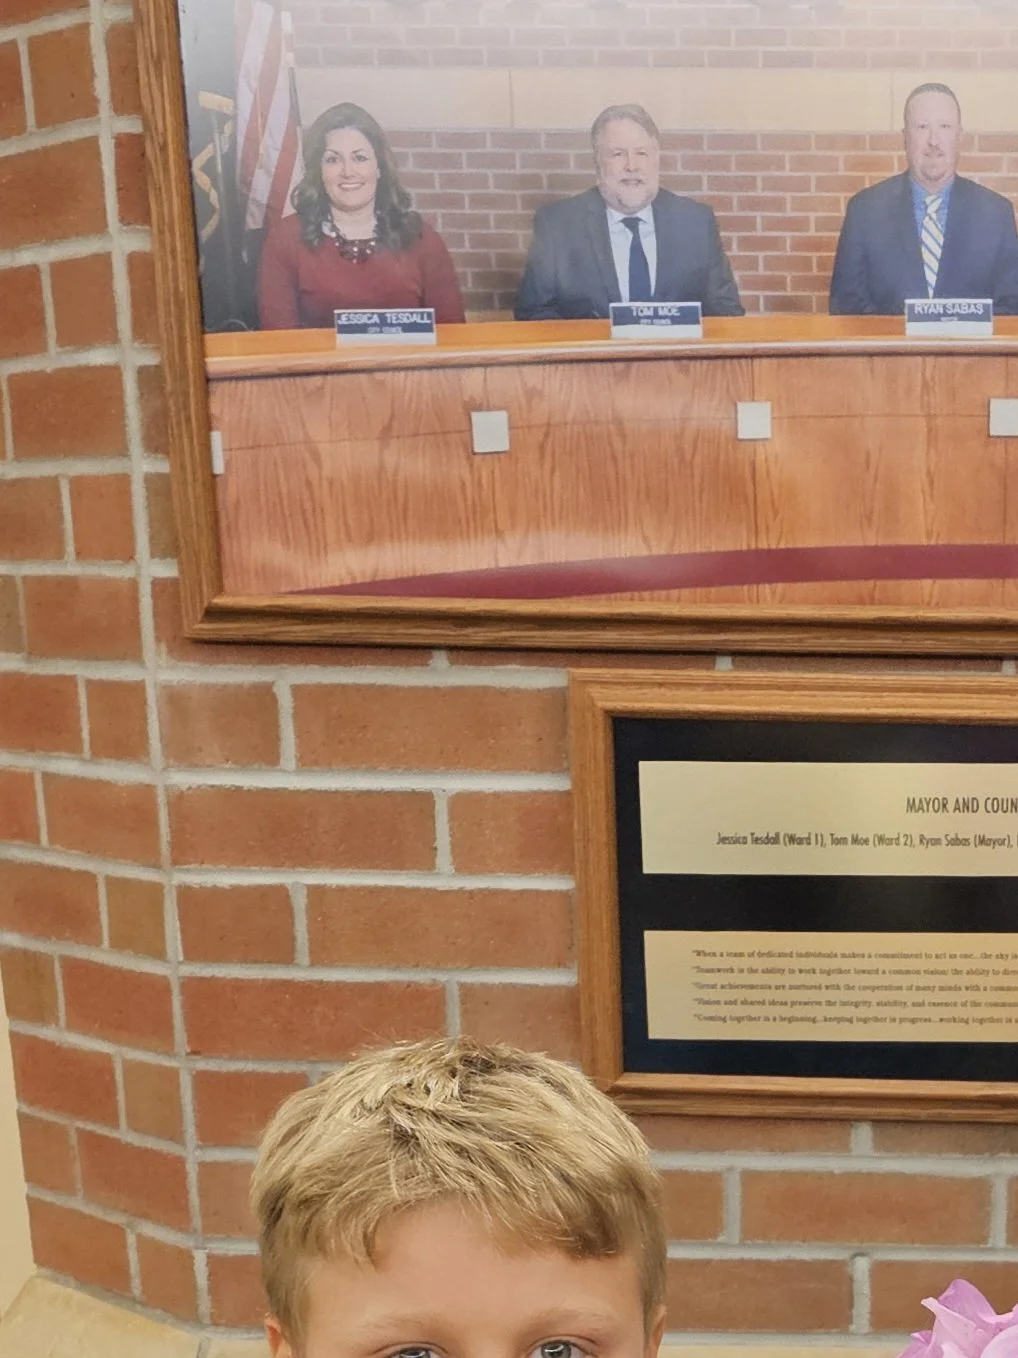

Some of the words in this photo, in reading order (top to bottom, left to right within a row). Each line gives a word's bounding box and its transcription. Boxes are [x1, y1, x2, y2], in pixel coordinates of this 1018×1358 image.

[631, 305, 654, 316] TOM
[658, 305, 681, 316] MOE
[914, 303, 943, 314] RYAN
[945, 303, 984, 315] SABAS
[338, 313, 380, 324] JESSICA
[384, 312, 431, 324] TESDALL
[906, 796, 949, 814] MAYOR
[953, 796, 979, 814] AND
[716, 832, 748, 845] Jessica
[750, 833, 780, 845] Tesdall
[783, 833, 811, 847] (Ward
[830, 833, 848, 846] Tom
[851, 833, 870, 846] Moe
[873, 833, 900, 847] (Ward
[919, 833, 942, 848] Ryan
[945, 834, 971, 846] Sabas
[973, 834, 1013, 849] (Mayor),
[757, 950, 793, 958] dedicated
[798, 966, 816, 974] work
